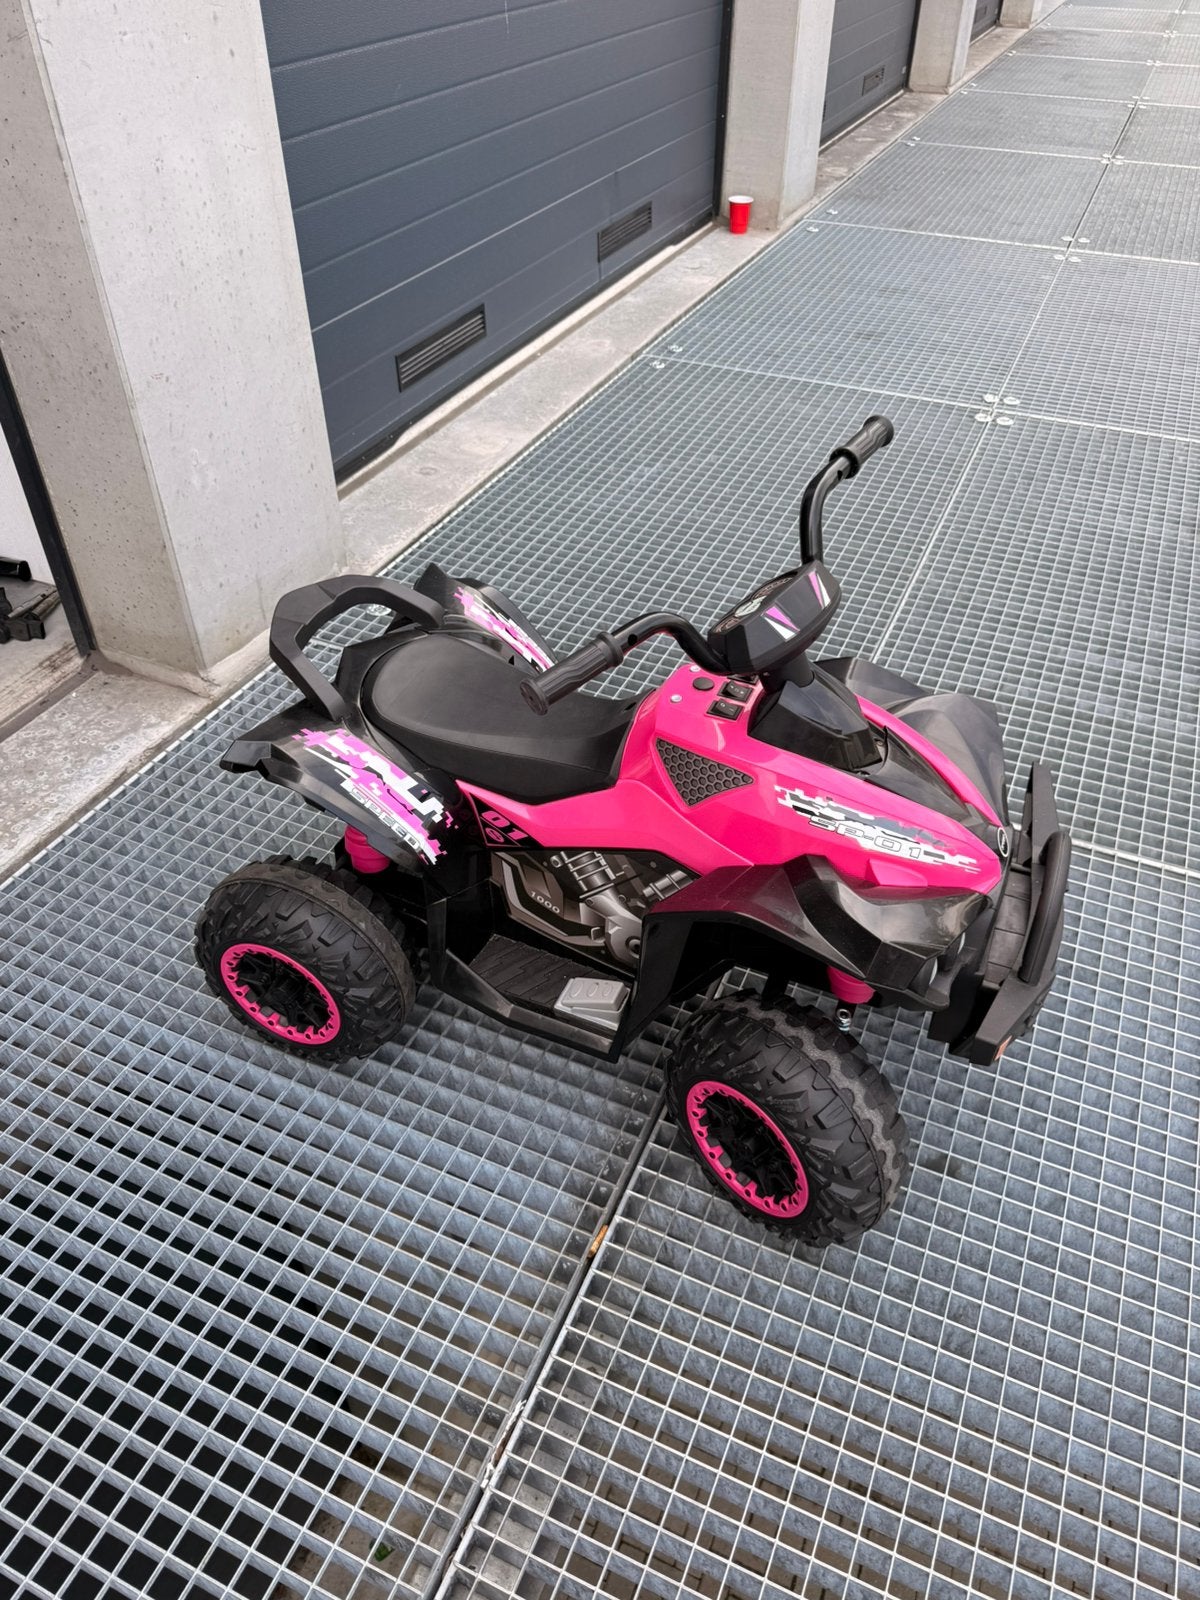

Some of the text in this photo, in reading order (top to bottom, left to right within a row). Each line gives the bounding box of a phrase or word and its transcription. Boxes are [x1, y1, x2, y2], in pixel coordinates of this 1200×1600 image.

[349, 786, 421, 850] SPEED
[481, 810, 529, 840] 01
[808, 815, 922, 859] SP-01
[530, 890, 561, 914] 1000
